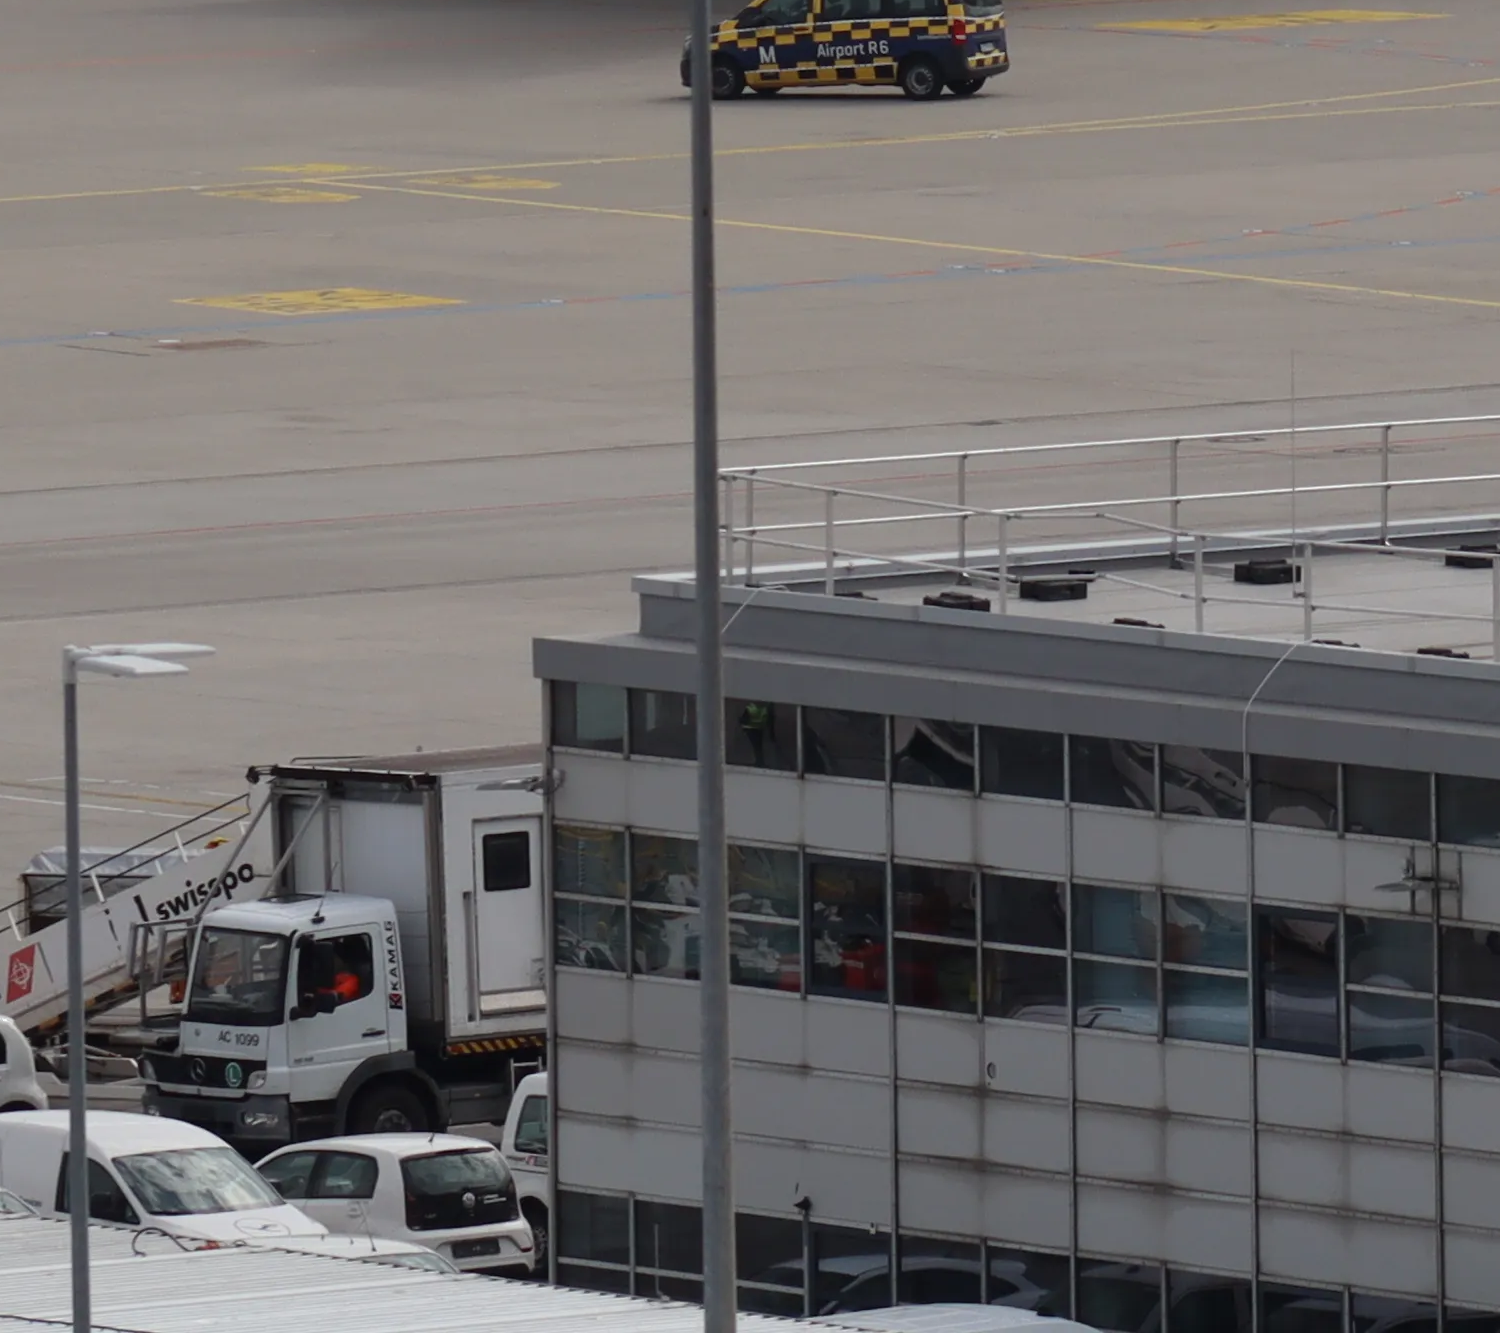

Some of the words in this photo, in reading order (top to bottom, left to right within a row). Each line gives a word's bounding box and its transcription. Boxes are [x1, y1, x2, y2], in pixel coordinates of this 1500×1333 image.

[760, 46, 777, 63] M
[817, 43, 866, 59] Airport
[156, 864, 254, 921] swisspo
[218, 1031, 231, 1043] AC
[235, 1034, 260, 1047] 1099
